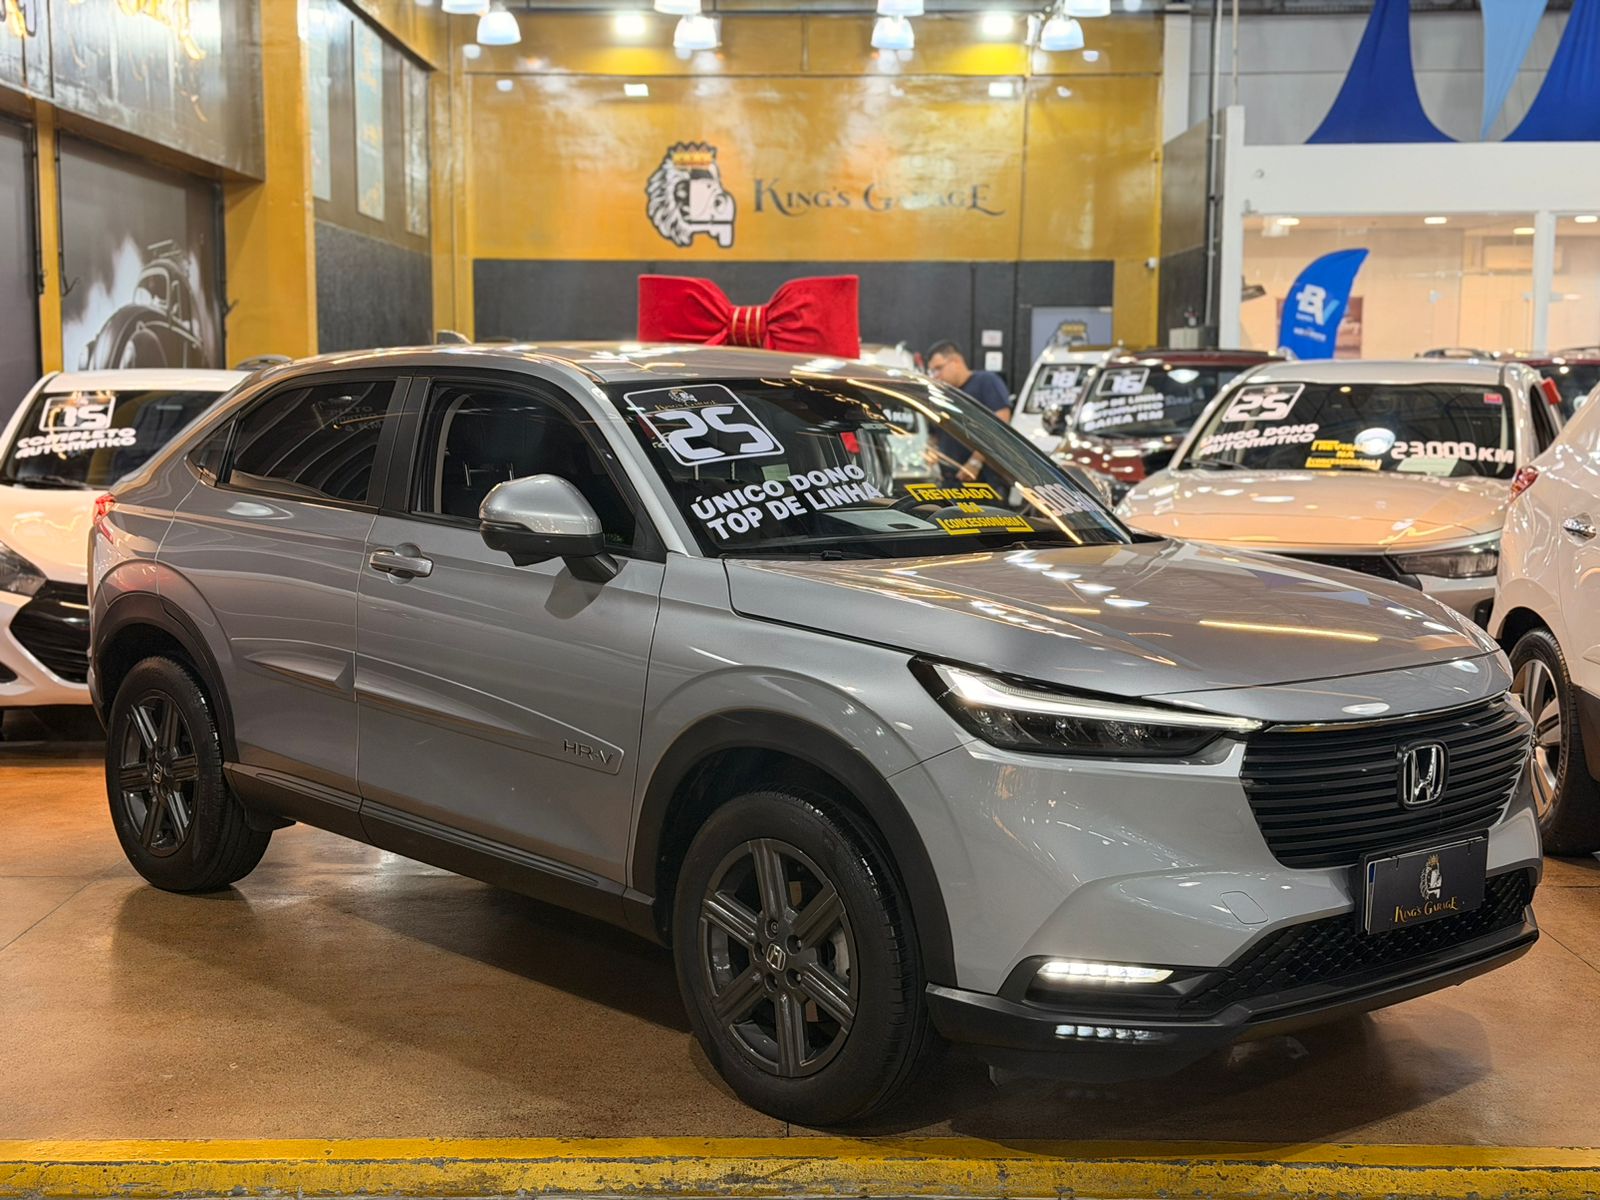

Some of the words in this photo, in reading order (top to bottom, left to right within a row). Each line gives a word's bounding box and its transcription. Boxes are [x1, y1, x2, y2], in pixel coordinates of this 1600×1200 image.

[862, 183, 1006, 217] GAGE
[1111, 375, 1142, 394] 16
[1137, 410, 1164, 422] KM
[1230, 393, 1290, 417] 25
[17, 428, 136, 448] COMPLETO
[654, 406, 775, 461] 25
[1263, 423, 1319, 437] DONO
[690, 479, 785, 520] ÚNICO
[787, 464, 865, 492] DONO
[917, 488, 995, 501] REVISADO
[706, 507, 763, 540] TOP
[765, 496, 808, 521] DE
[804, 481, 885, 511] LINHA
[956, 502, 985, 513] NA
[563, 739, 614, 764] HR-V
